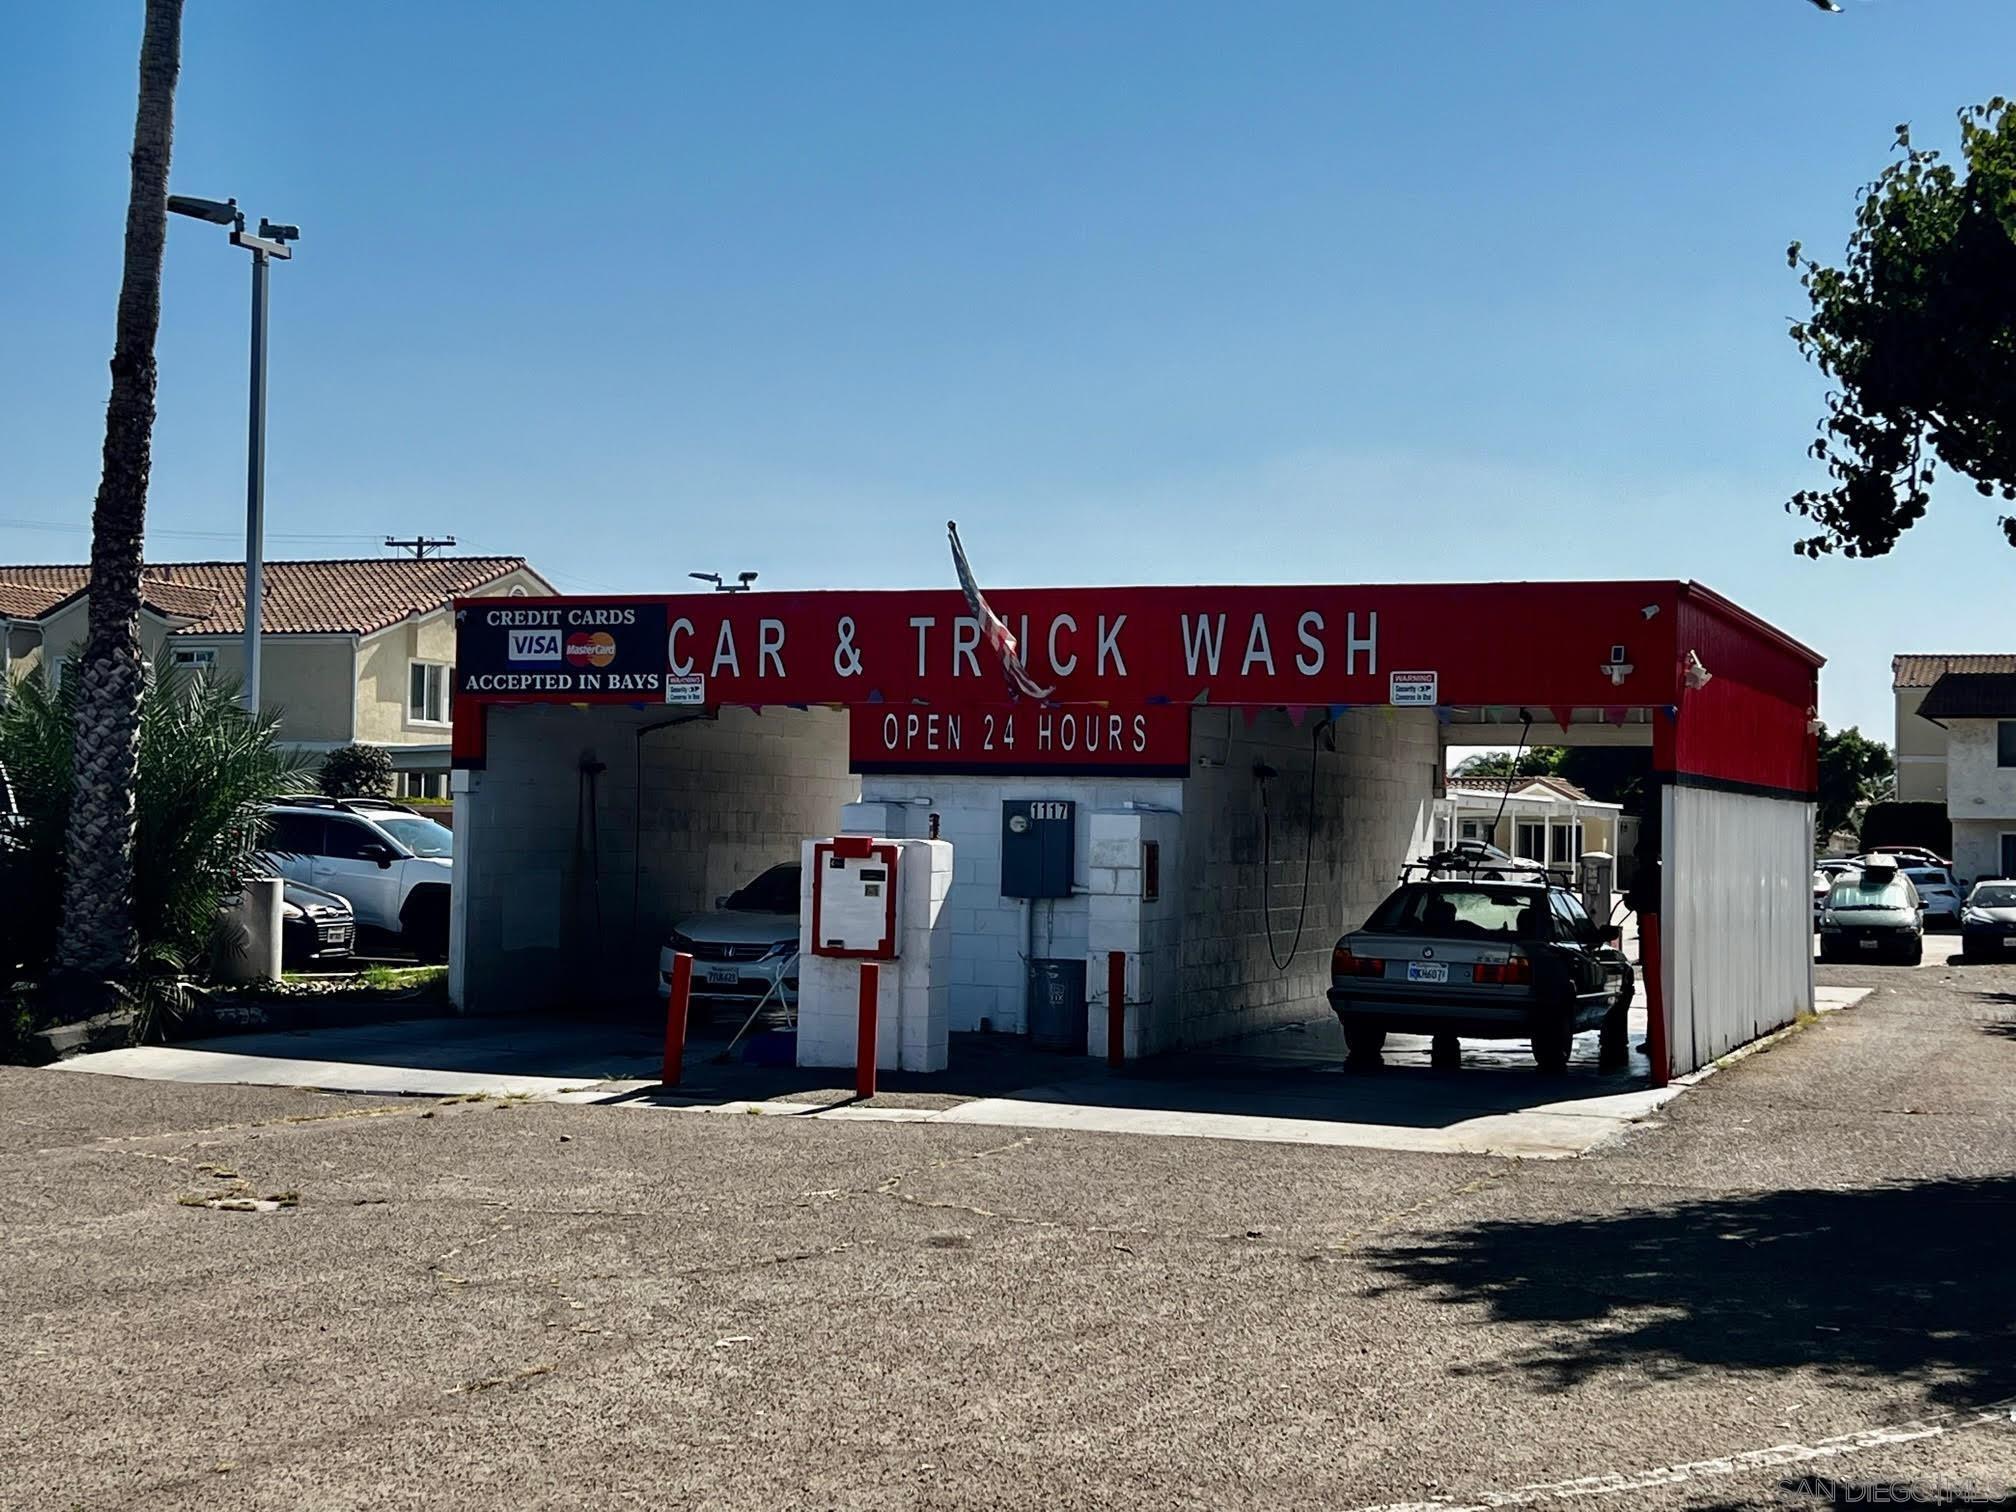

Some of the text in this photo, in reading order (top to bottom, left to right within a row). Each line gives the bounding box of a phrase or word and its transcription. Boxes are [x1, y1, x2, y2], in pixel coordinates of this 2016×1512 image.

[487, 609, 636, 626] CREDIT CARDS
[513, 635, 559, 655] VISA
[566, 644, 615, 656] MasterCard
[668, 617, 786, 677] CAR
[834, 615, 863, 678] &
[1181, 611, 1377, 676] WASH
[465, 673, 659, 690] ACCEPTED IN BAYS
[884, 713, 1146, 752] OPEN 24 HOURS
[1032, 802, 1068, 819] 1117
